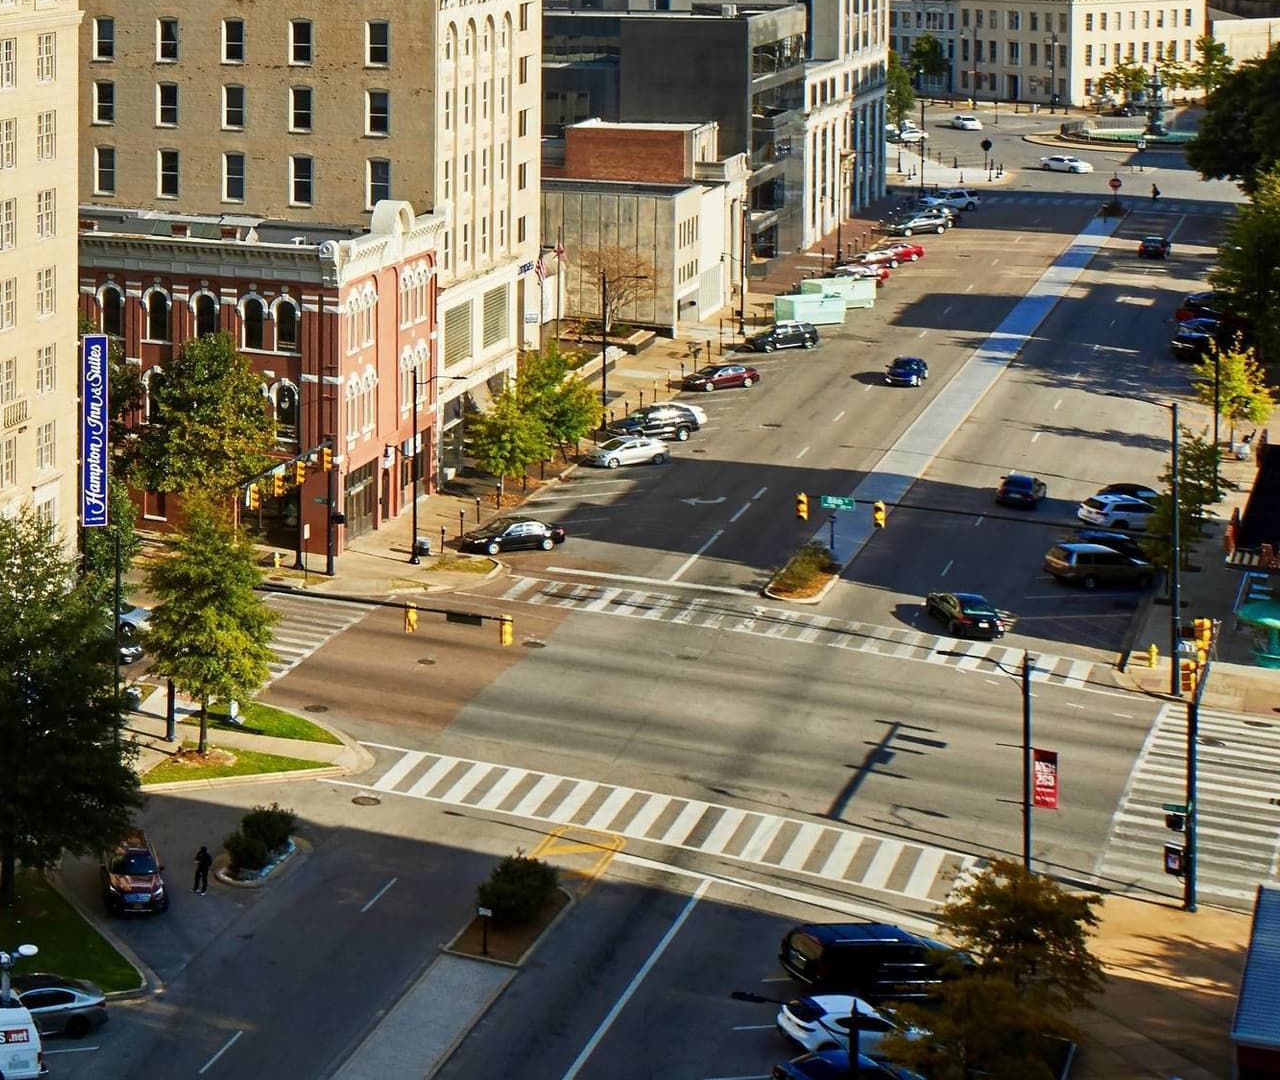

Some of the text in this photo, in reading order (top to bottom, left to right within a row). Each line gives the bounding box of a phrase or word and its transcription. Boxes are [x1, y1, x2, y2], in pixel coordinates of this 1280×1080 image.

[87, 345, 102, 386] Suites
[87, 395, 104, 435] Inn
[85, 436, 105, 514] Hampton
